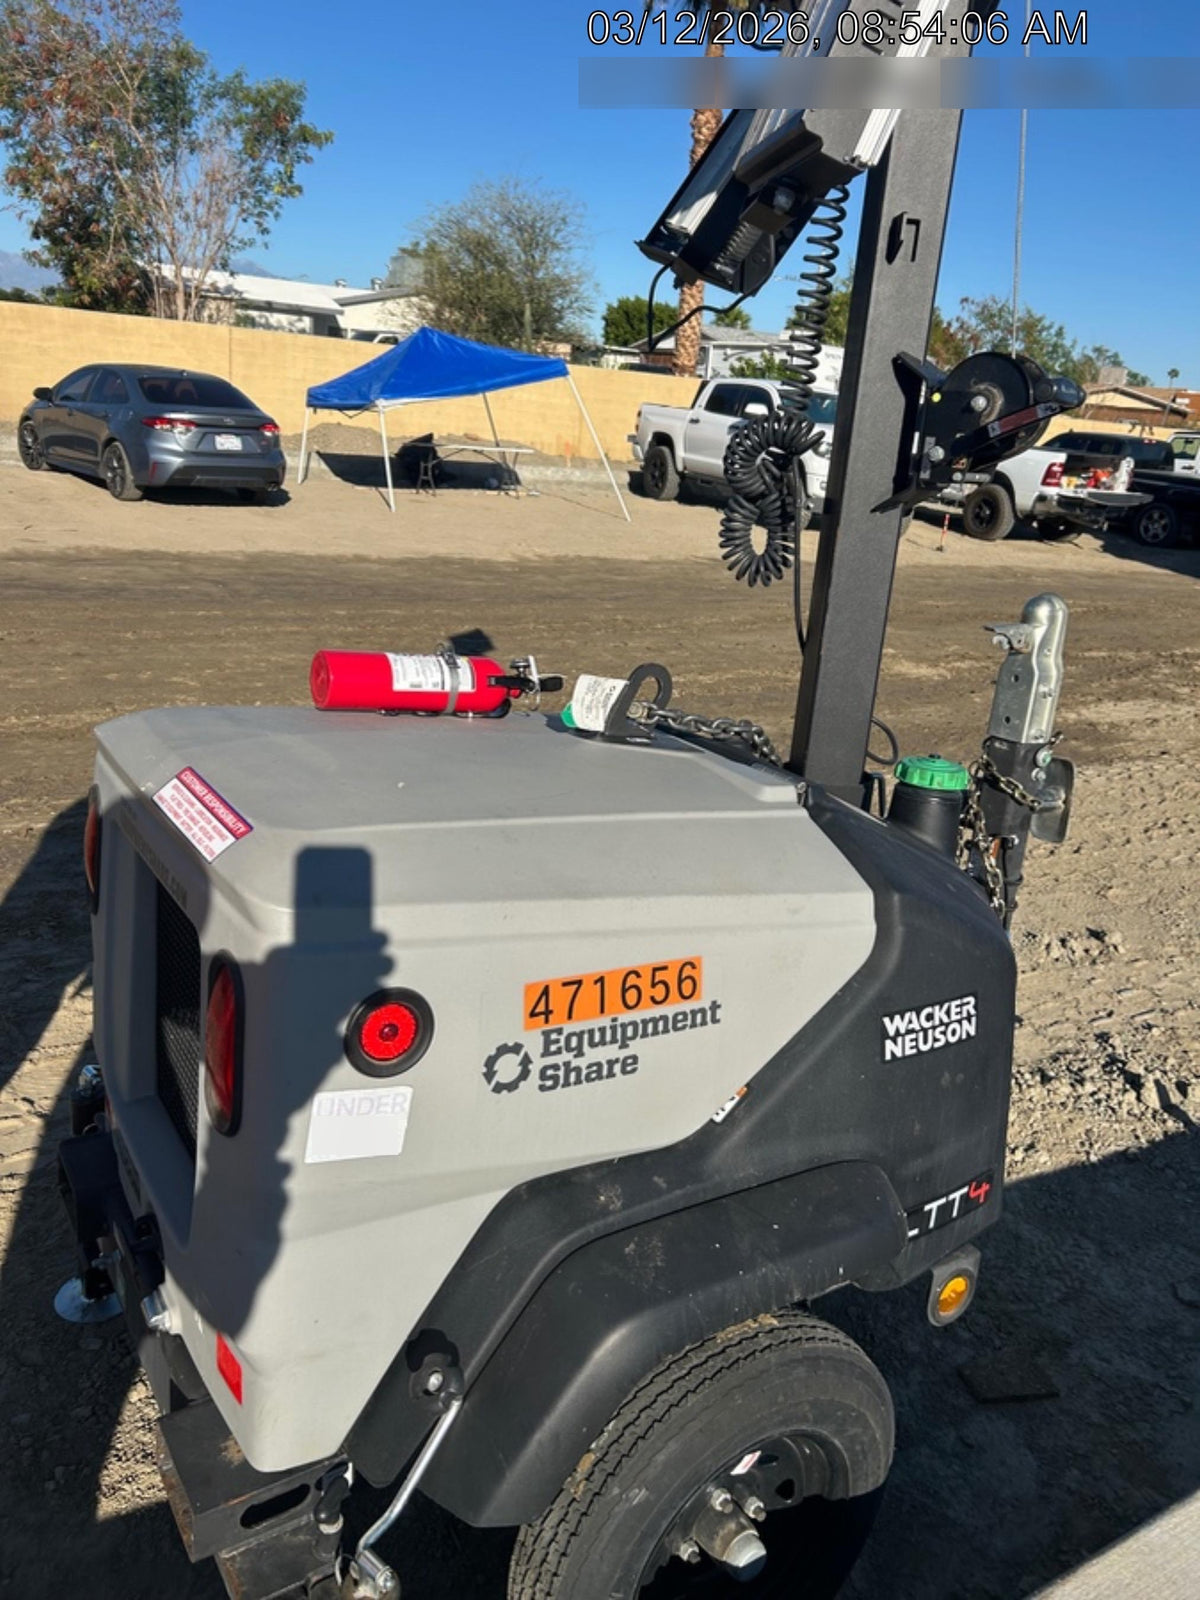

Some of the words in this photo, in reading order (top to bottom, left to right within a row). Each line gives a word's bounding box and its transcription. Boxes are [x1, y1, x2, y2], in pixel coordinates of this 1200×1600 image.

[528, 960, 698, 1025] 471656
[540, 1000, 722, 1058] Equipment
[882, 995, 977, 1037] WACKER
[885, 1016, 977, 1061] NEUSON
[538, 1054, 640, 1092] Share
[316, 1093, 409, 1117] UNDER
